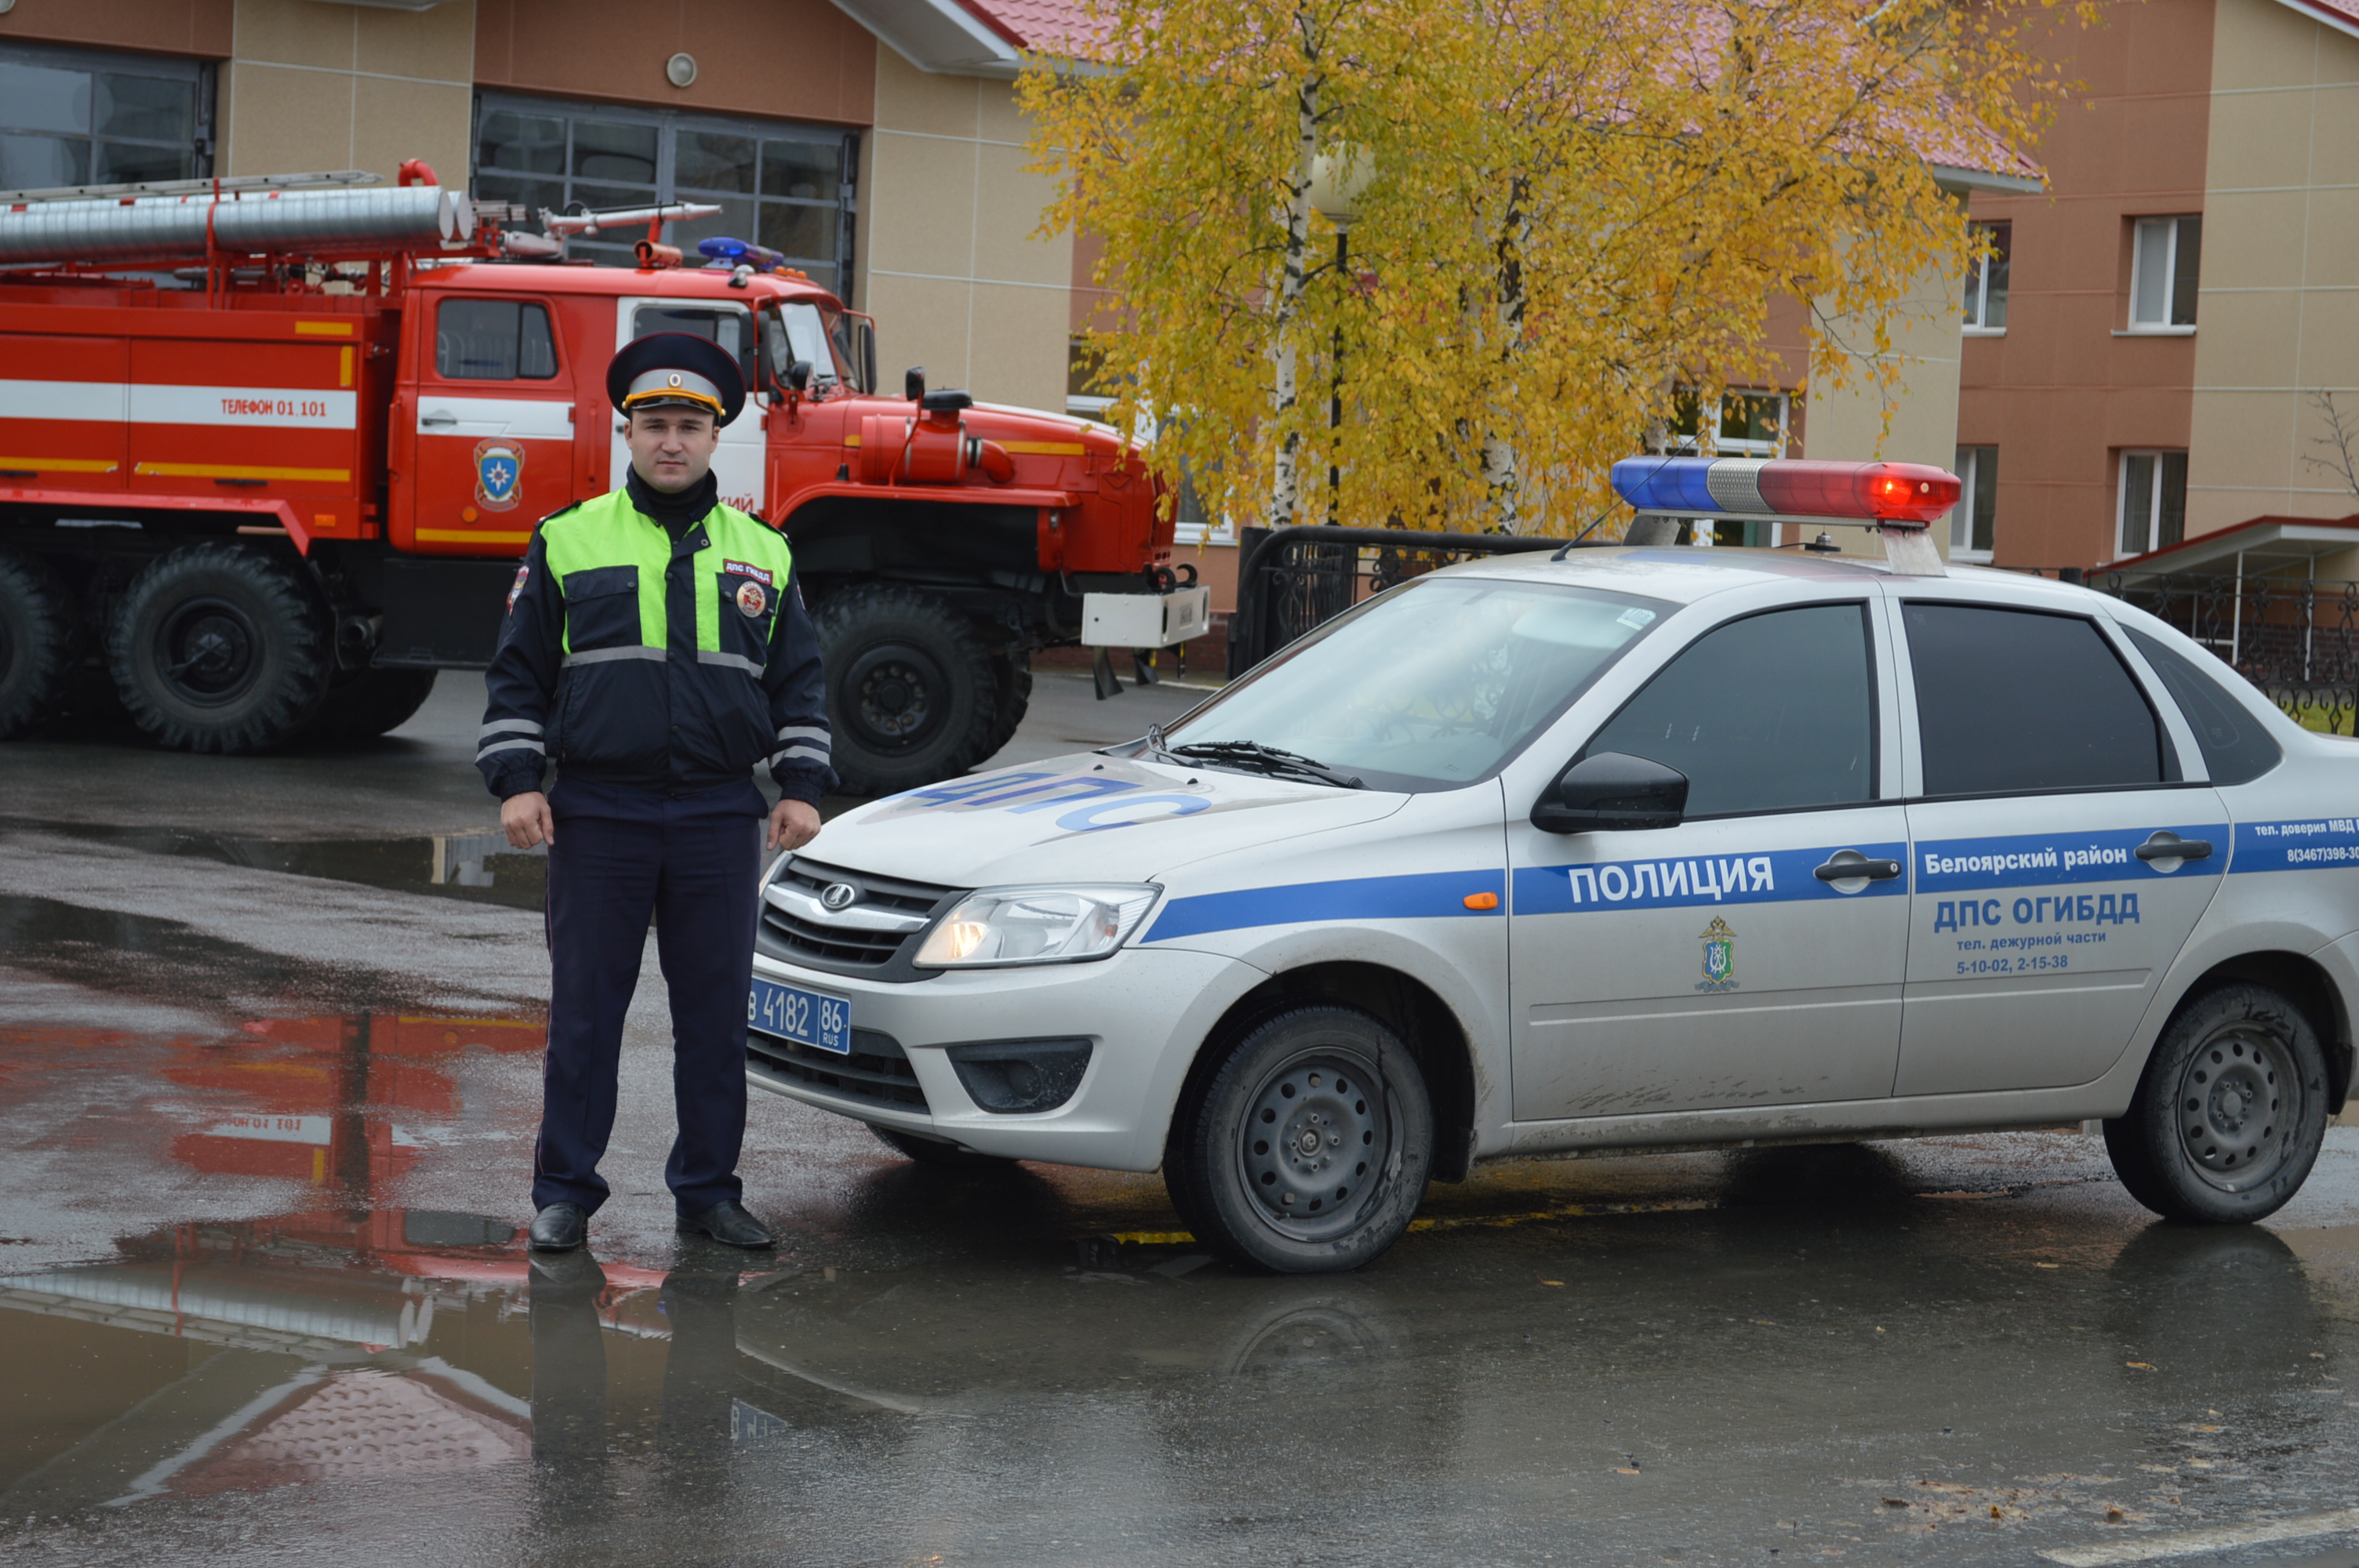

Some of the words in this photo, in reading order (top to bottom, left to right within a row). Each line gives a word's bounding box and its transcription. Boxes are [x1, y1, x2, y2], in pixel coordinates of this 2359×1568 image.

[221, 398, 273, 415] ТЕЛЕФОН
[725, 562, 744, 572] ДПС
[2255, 826, 2279, 837] тел.
[2281, 823, 2327, 837] доверия
[2328, 818, 2356, 834] МВД
[1925, 847, 2058, 876] Белоярский
[2063, 844, 2128, 871] район
[1568, 856, 1775, 903] ПОЛИЦИЯ
[1934, 898, 2002, 934] ДПС
[2012, 893, 2140, 925] ОГИБДД
[1957, 940, 1986, 951] тел.
[1990, 932, 2063, 952] дежурной
[2066, 932, 2106, 944] части
[1957, 958, 2013, 975] 5-10-02,
[2017, 955, 2068, 971] 2-15-38
[763, 988, 809, 1037] 4182
[821, 1000, 842, 1033] 86
[823, 1032, 839, 1047] RUS
